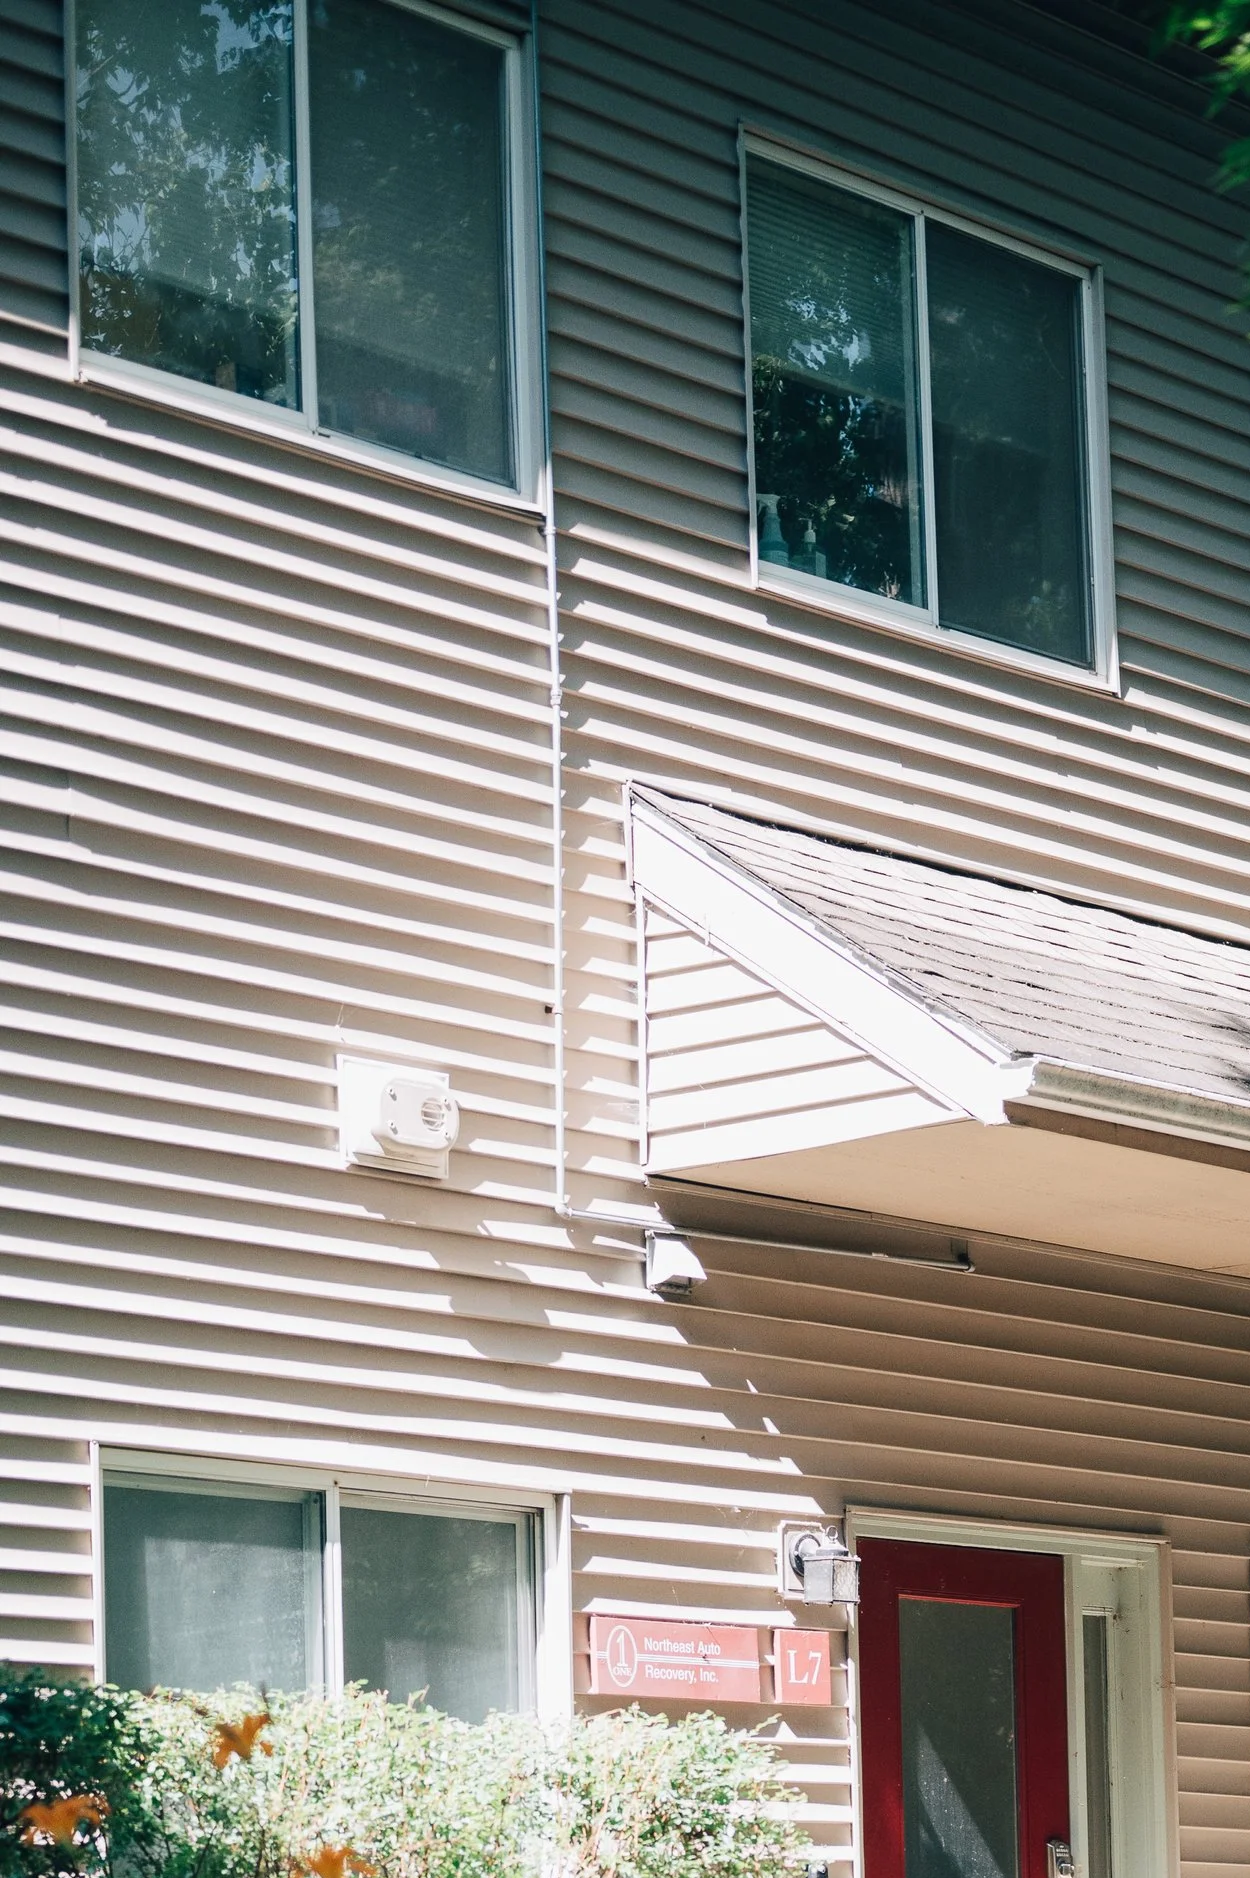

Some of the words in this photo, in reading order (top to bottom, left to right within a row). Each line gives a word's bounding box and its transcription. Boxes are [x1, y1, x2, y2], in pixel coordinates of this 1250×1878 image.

[644, 1636, 696, 1655] Northeast
[697, 1640, 721, 1656] Auto
[612, 1667, 632, 1677] ONE
[645, 1666, 698, 1685] Recovery,
[699, 1669, 719, 1683] Inc.
[787, 1649, 823, 1685] L7
